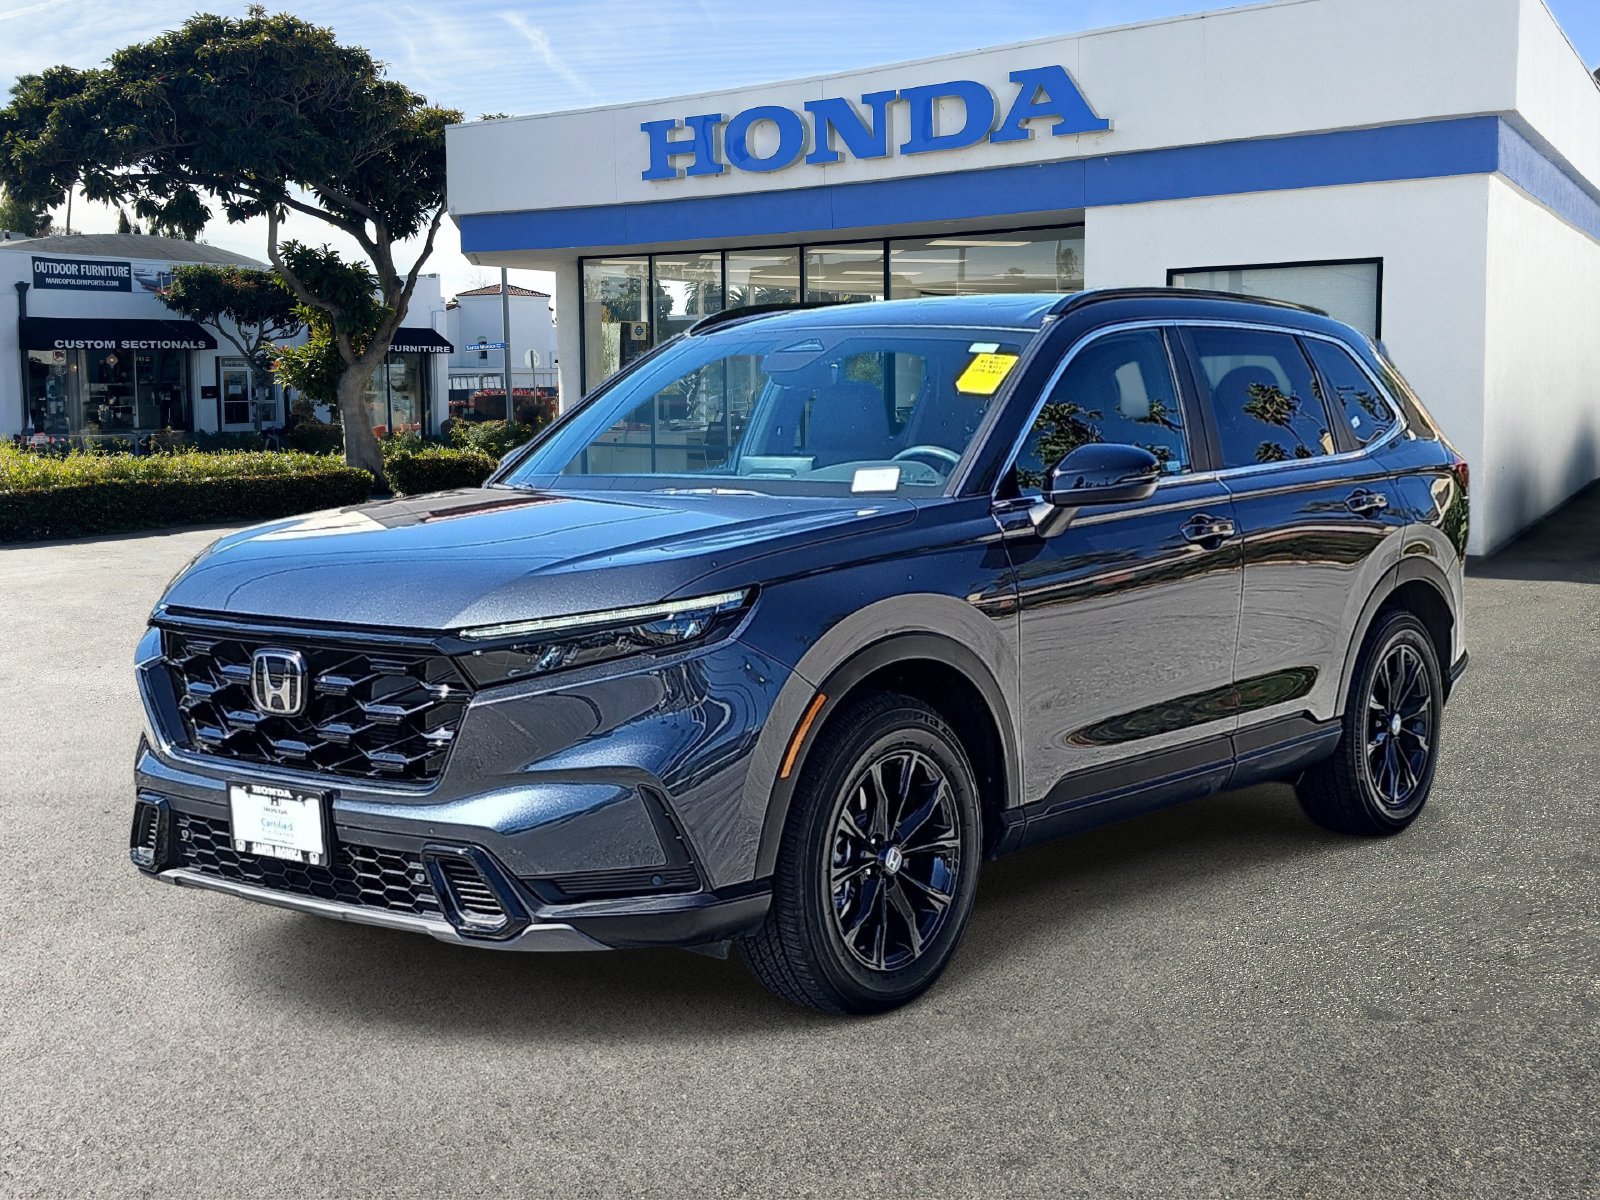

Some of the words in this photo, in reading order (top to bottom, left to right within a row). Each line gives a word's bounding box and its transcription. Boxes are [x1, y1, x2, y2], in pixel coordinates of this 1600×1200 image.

[640, 64, 1113, 181] HONDA
[34, 261, 79, 275] OUTDOOR
[80, 264, 130, 277] FURNITURE
[45, 277, 119, 287] MARCOPOLOIMPORTS.COM
[54, 339, 116, 349] CUSTOM
[121, 340, 206, 349] SECTIONALS
[388, 344, 451, 353] FURNITURE
[252, 785, 293, 798] HONDA
